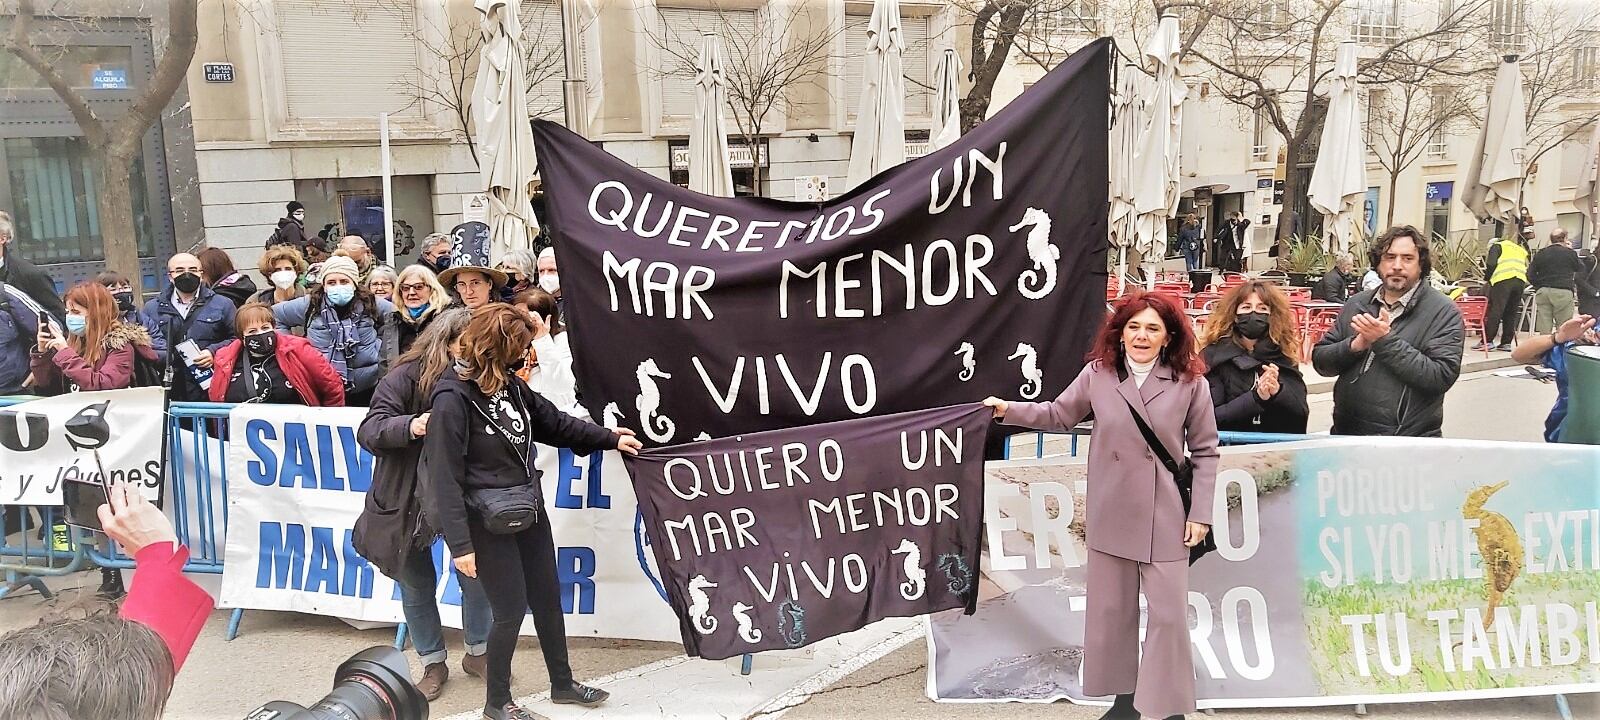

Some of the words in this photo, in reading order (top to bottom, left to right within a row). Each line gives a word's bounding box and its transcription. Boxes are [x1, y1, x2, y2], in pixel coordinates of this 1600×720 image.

[588, 180, 891, 253] QUEREMOS
[929, 142, 1006, 215] UN
[603, 250, 714, 320] MAR
[779, 234, 997, 320] MENOR
[692, 352, 876, 416] VIVO
[554, 447, 611, 510] EL
[901, 427, 963, 471] UN
[14, 474, 34, 501] y
[664, 507, 759, 561] MAR
[809, 483, 960, 539] MENOR
[1318, 465, 1435, 518] PORQUE
[1318, 526, 1355, 588] SI
[1366, 523, 1413, 585] YO
[1428, 518, 1482, 581] ME
[1524, 509, 1600, 574] EXTI
[1341, 612, 1412, 678] TU
[1427, 600, 1600, 673] TAMBI
